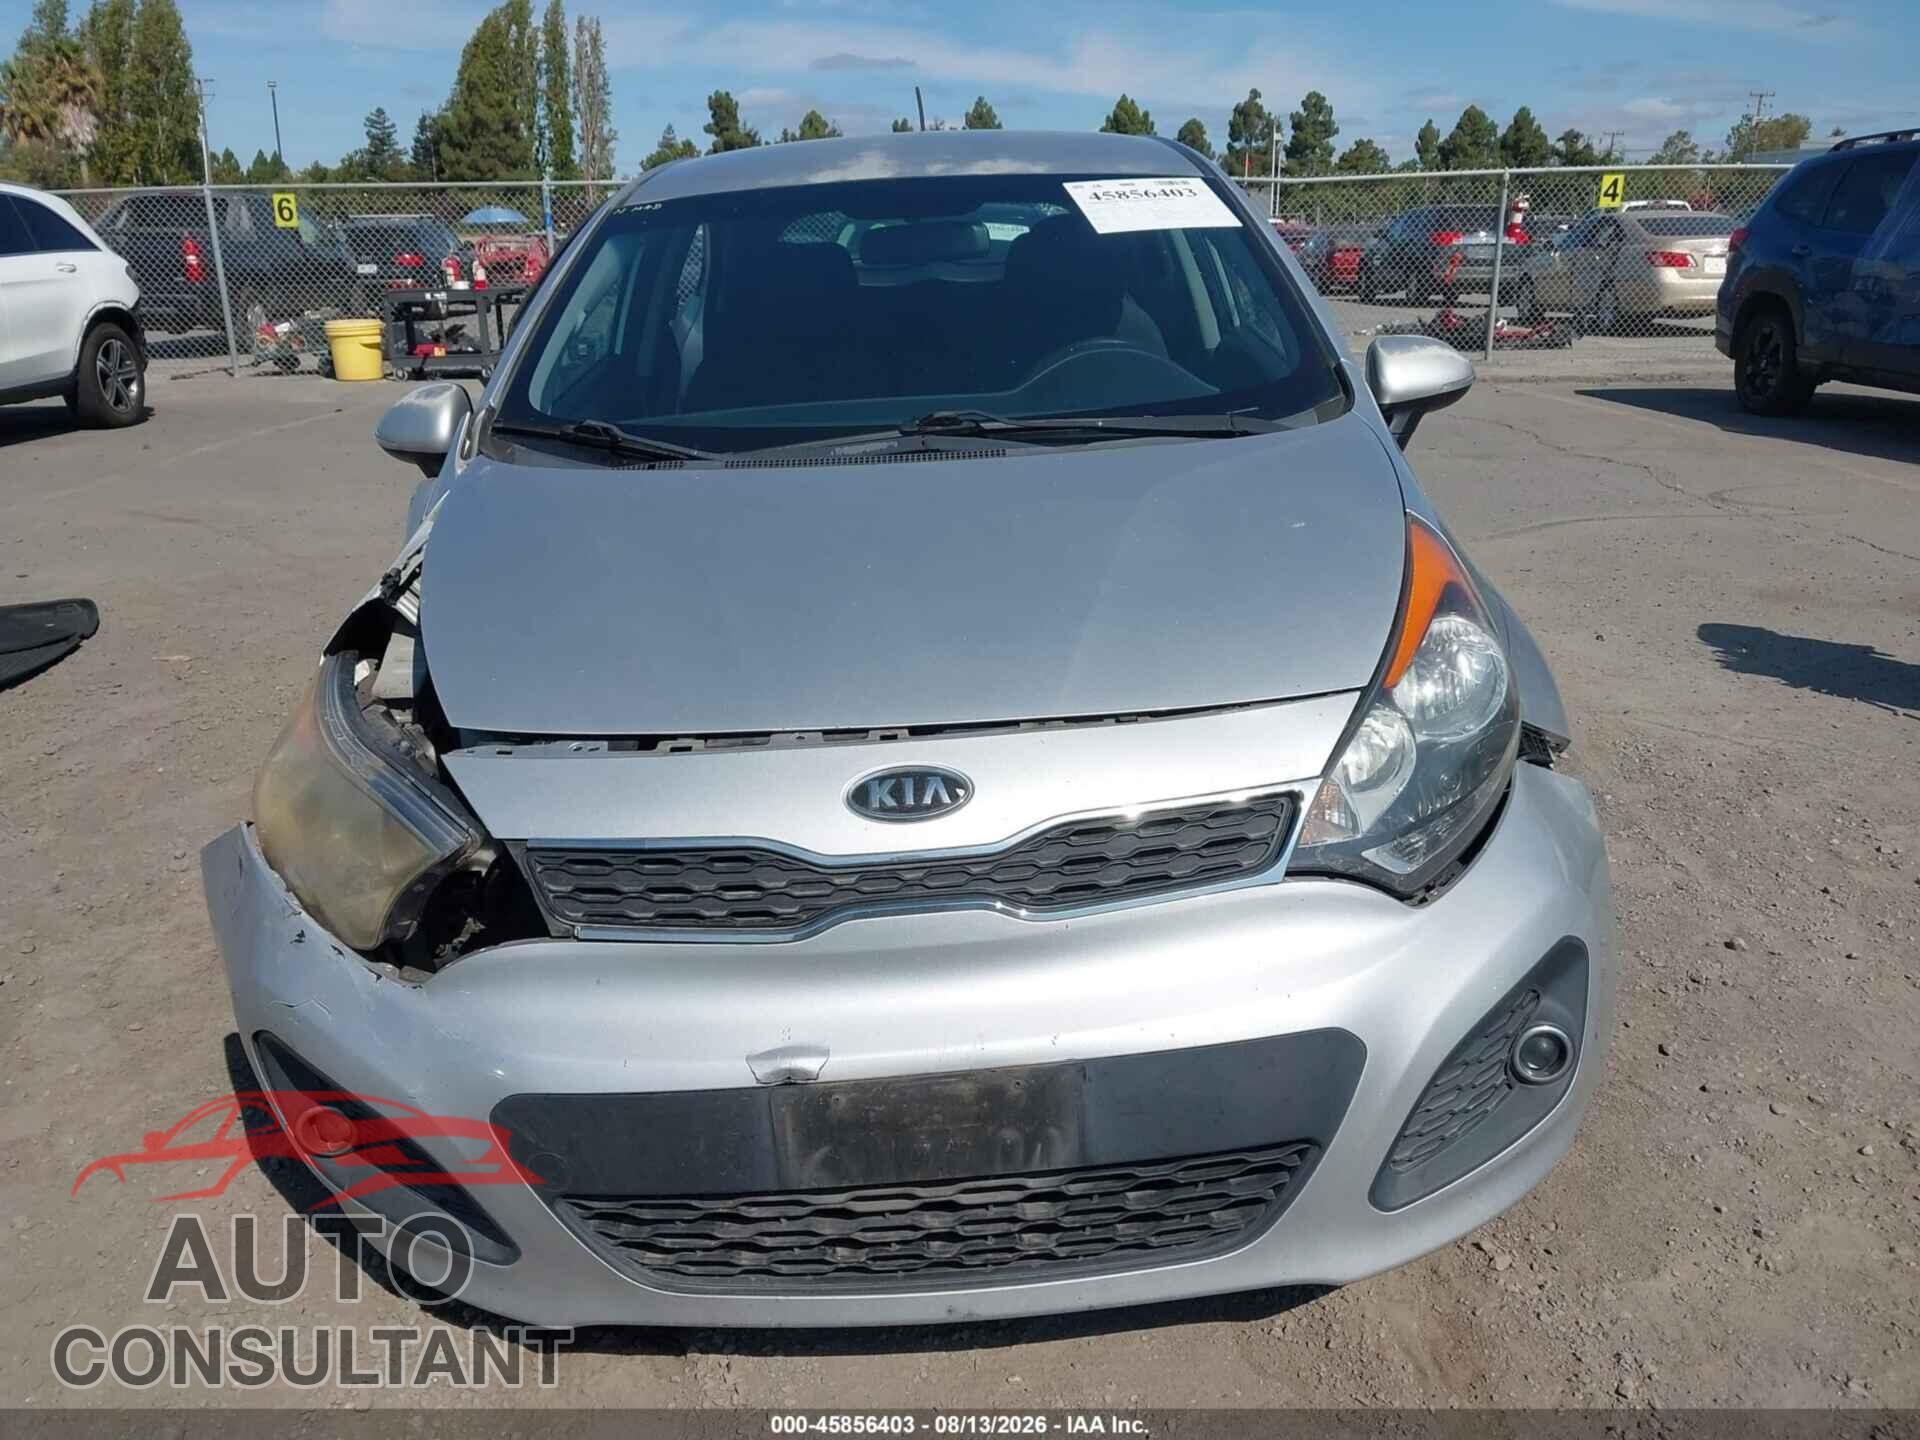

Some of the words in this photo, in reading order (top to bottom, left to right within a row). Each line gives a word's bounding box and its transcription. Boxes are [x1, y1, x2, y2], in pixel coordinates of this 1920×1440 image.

[1089, 188, 1197, 201] 45856403
[1603, 177, 1619, 202] 4
[277, 198, 294, 222] 6
[867, 776, 952, 809] KIA
